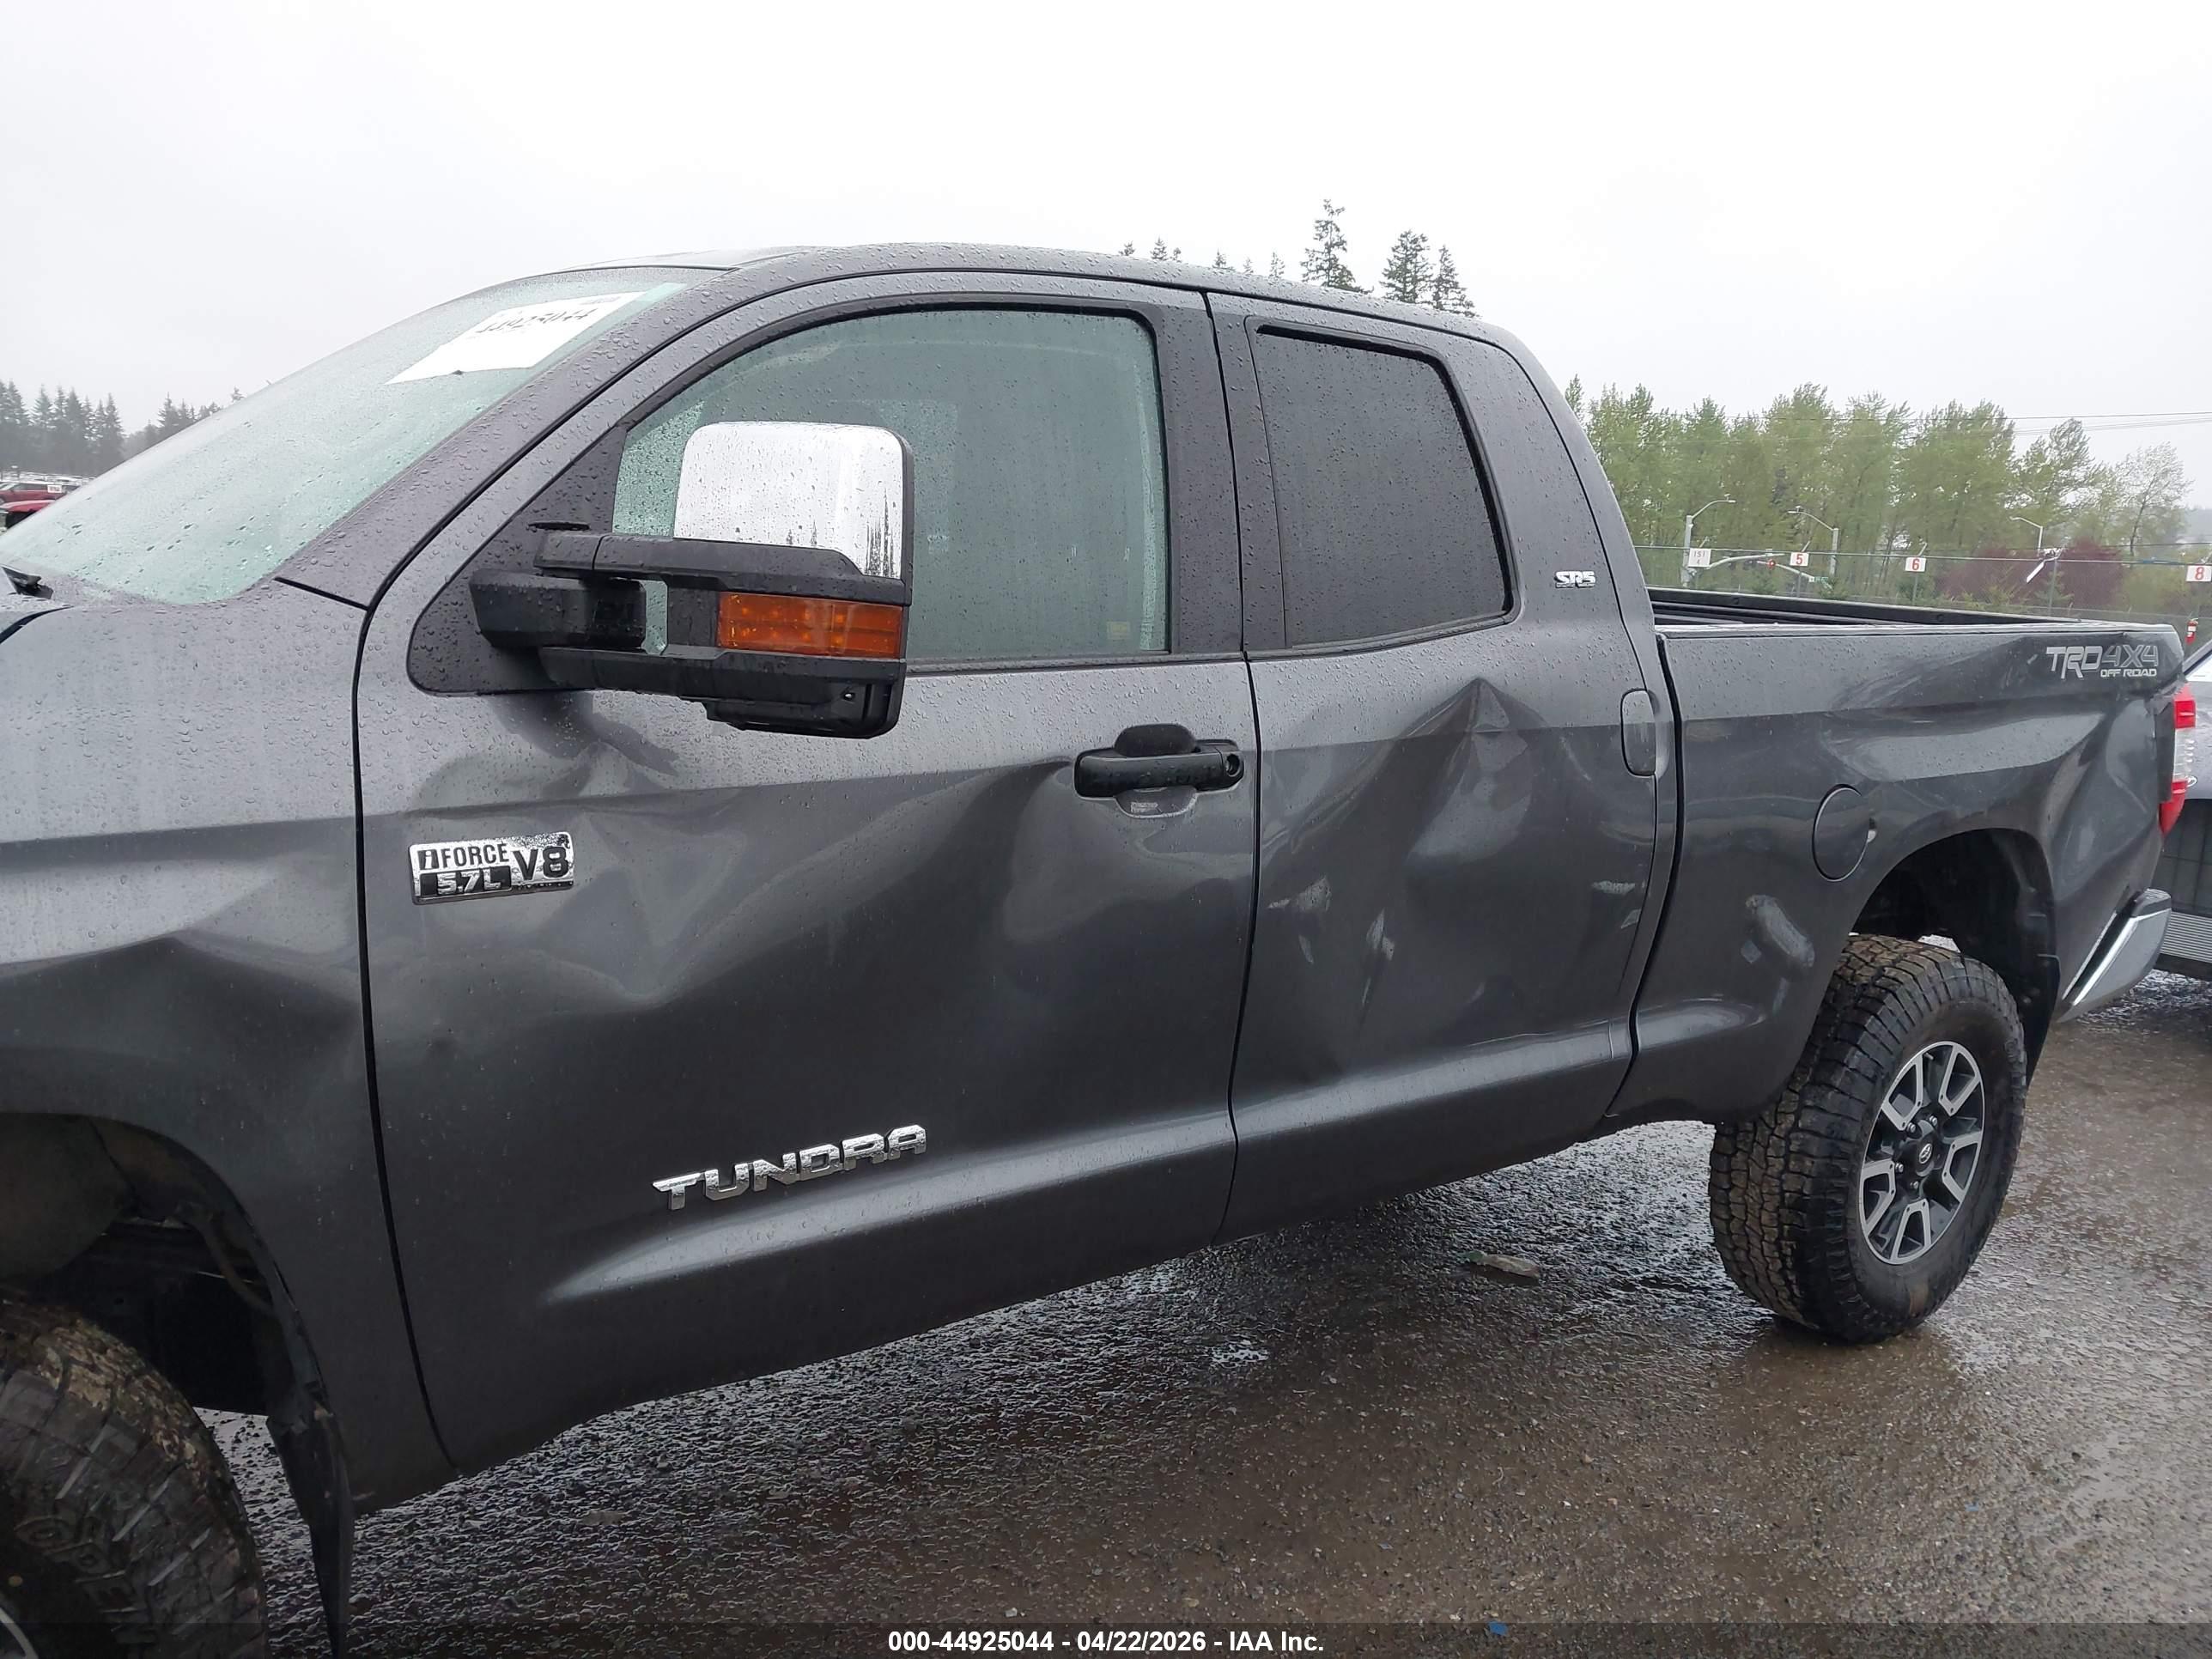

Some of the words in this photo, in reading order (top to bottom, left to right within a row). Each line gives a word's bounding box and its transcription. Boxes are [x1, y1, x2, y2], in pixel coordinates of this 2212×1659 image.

[1796, 553, 1804, 565] 5
[1911, 558, 1920, 571] 6
[1555, 570, 1596, 588] SR5
[2195, 566, 2205, 580] 8
[2045, 645, 2103, 679] TRD
[2101, 644, 2159, 668] 4X4
[2100, 668, 2122, 678] OFF
[2123, 668, 2158, 678] ROAD
[513, 846, 569, 881] V8
[436, 868, 501, 896] 5.7L
[651, 1123, 928, 1212] TUNDRA
